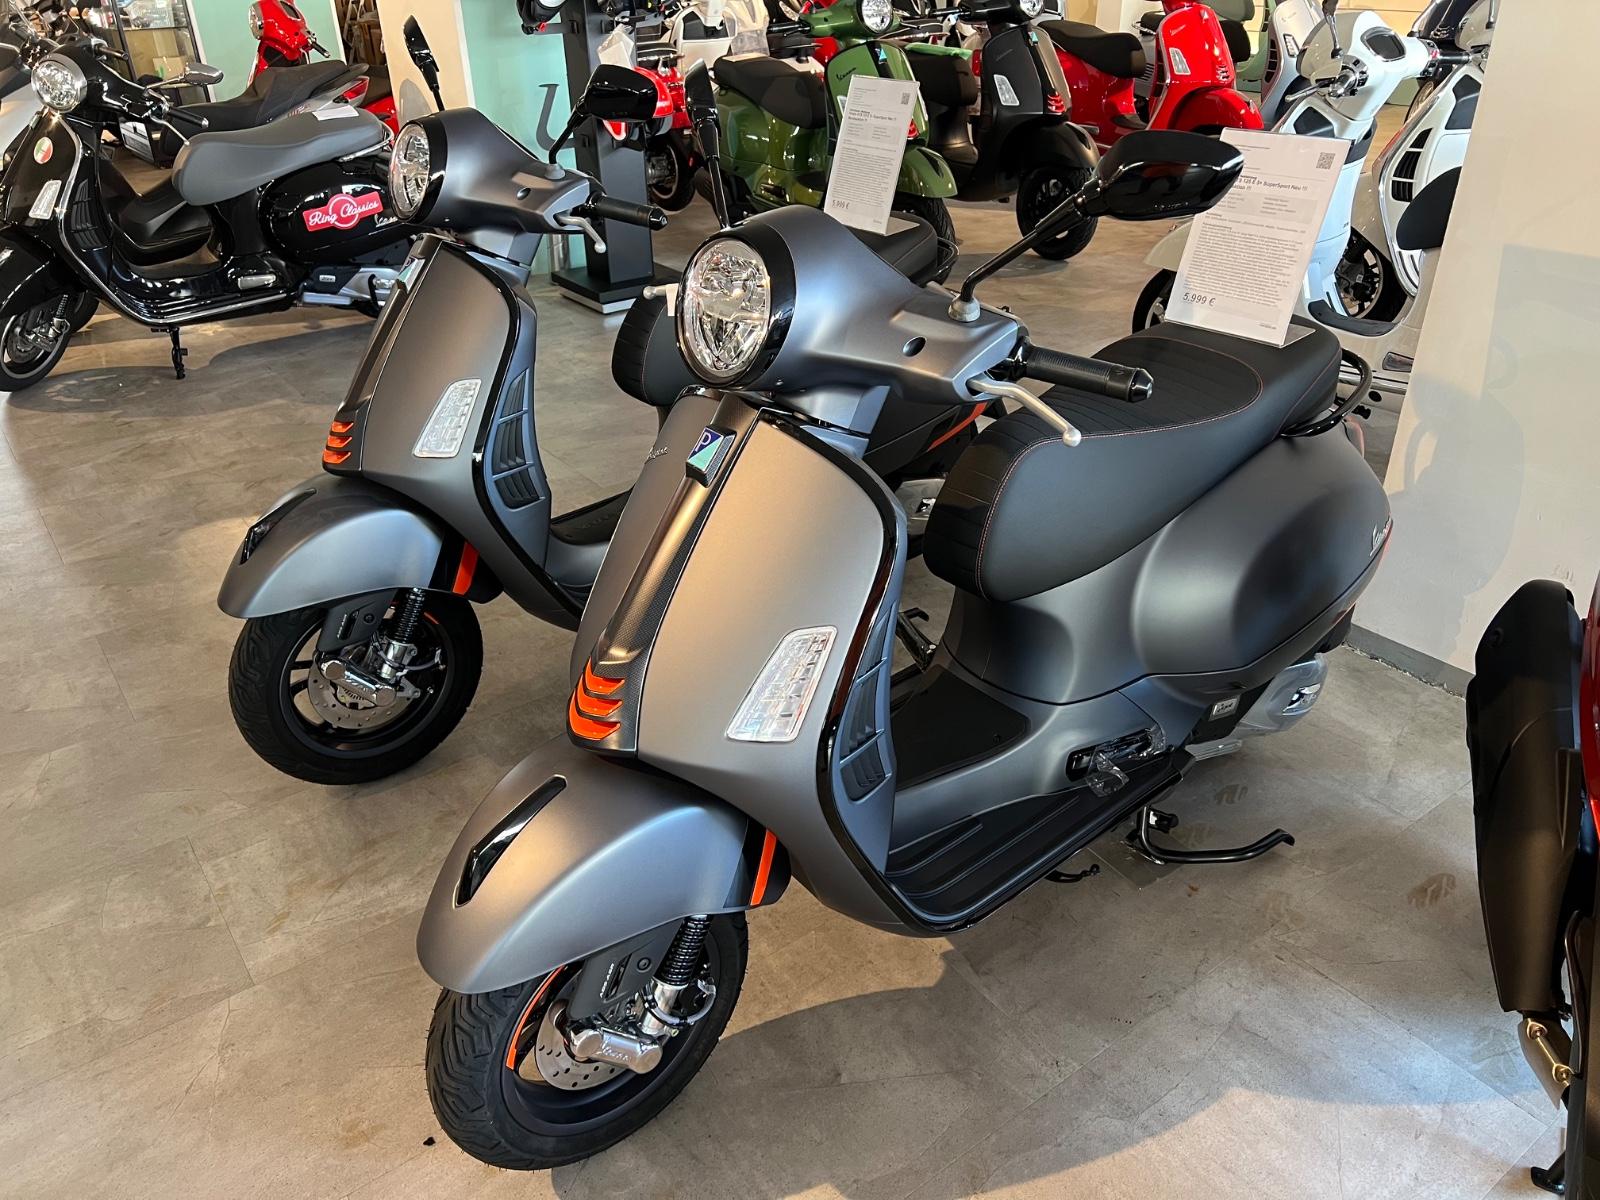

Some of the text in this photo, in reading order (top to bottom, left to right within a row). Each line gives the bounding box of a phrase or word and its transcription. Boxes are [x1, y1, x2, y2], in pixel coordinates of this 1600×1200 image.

[1263, 181, 1291, 190] SuperSport
[308, 200, 379, 226] Ring Classics
[1182, 291, 1217, 307] 5.999 €
[694, 431, 712, 452] P
